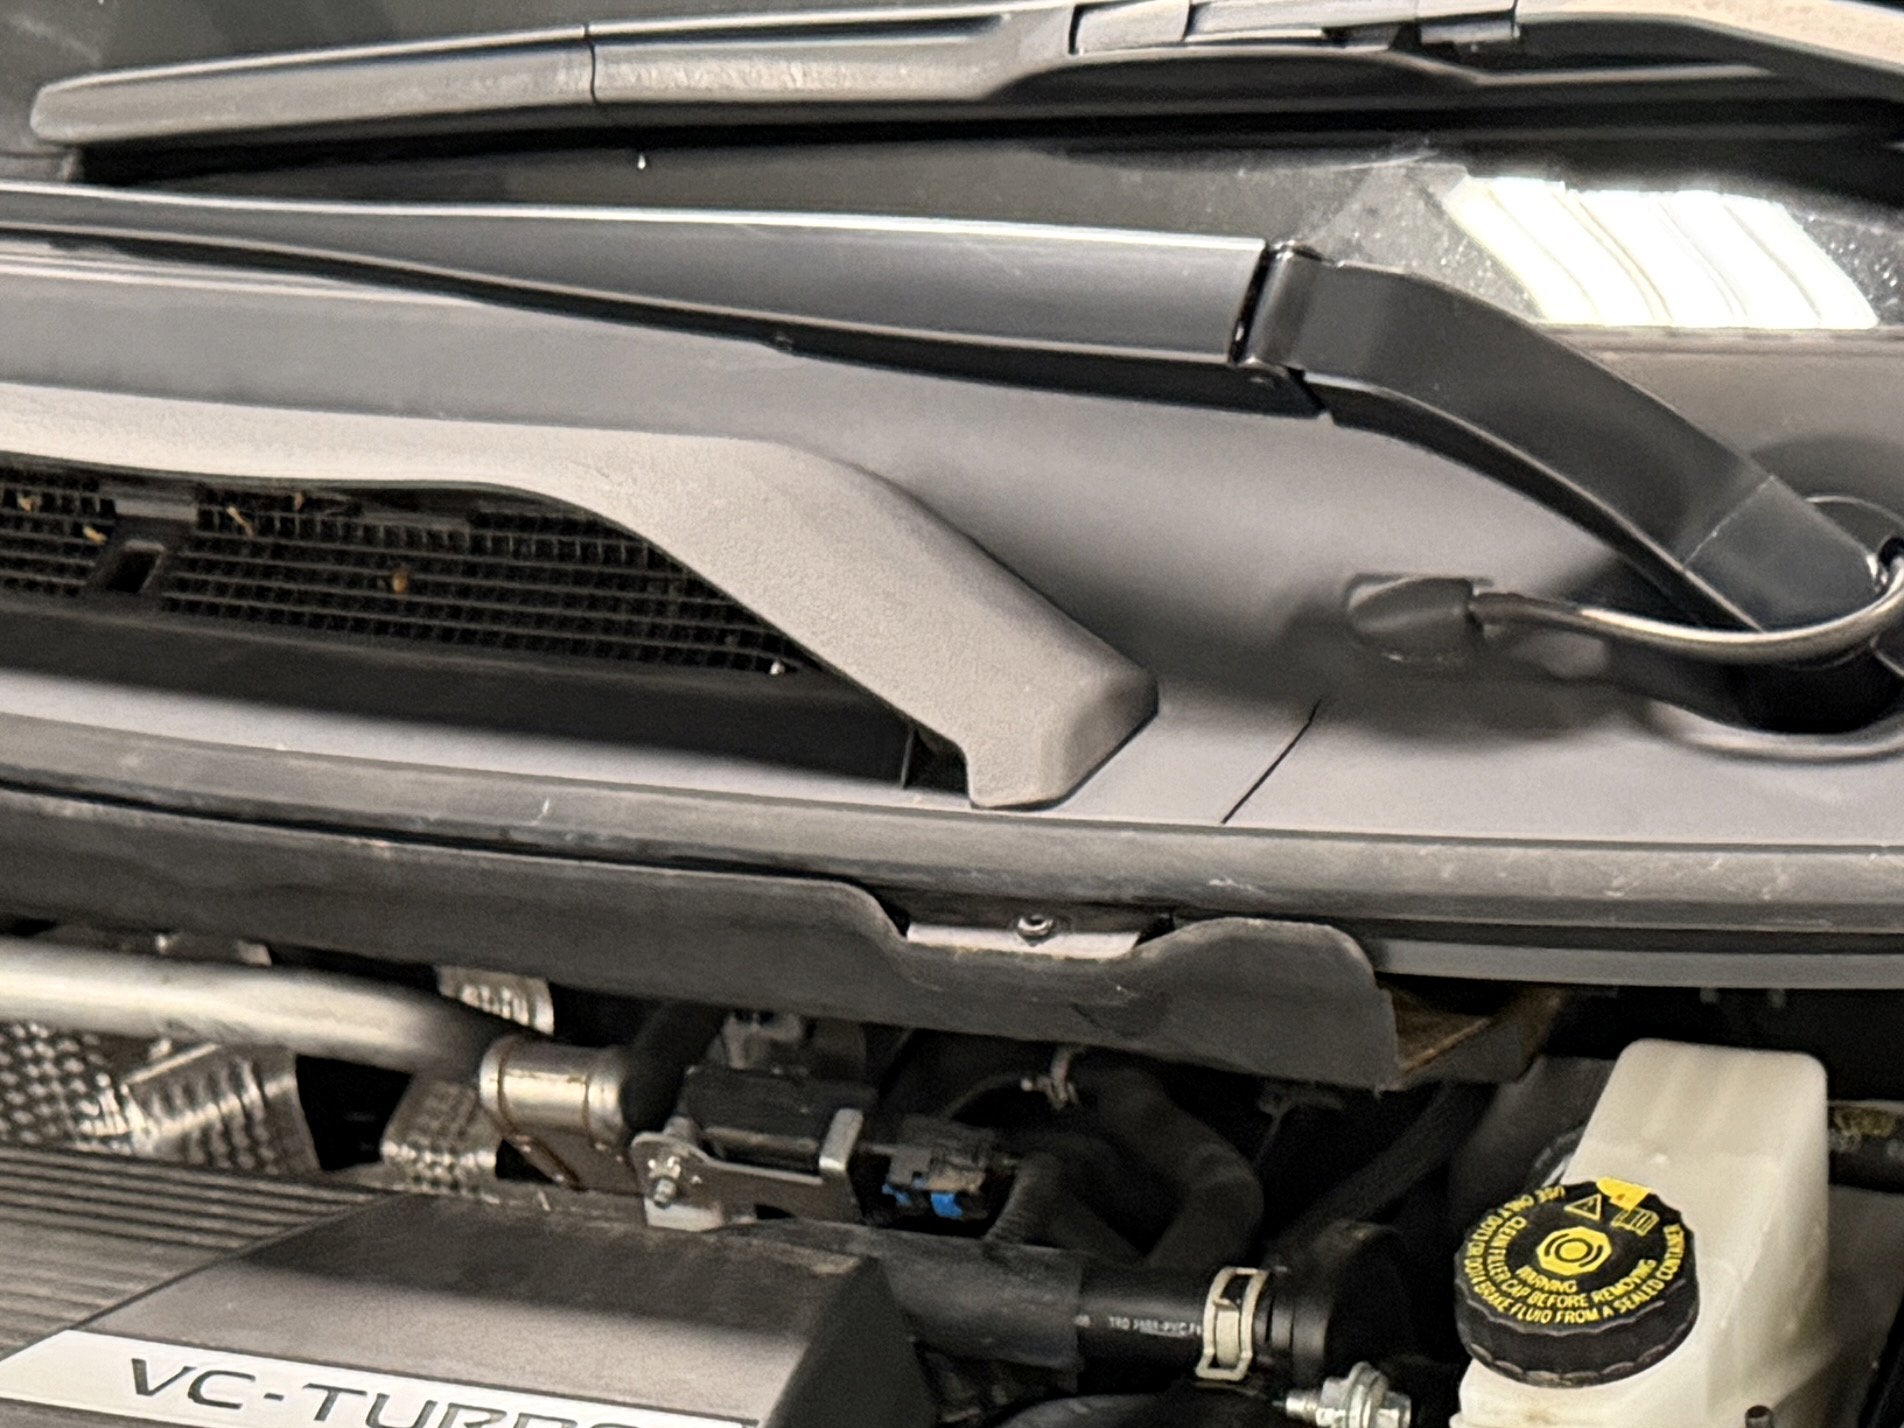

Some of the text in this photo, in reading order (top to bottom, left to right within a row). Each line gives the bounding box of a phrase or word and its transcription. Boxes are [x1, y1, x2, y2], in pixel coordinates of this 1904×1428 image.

[1501, 1279, 1530, 1298] CAP
[1527, 1291, 1589, 1307] BEFORE
[1591, 1259, 1657, 1302] REMOVING
[1515, 1264, 1578, 1292] WARNING
[1554, 1308, 1600, 1323] FROM
[1602, 1305, 1614, 1318] A
[1613, 1279, 1665, 1313] SEALED
